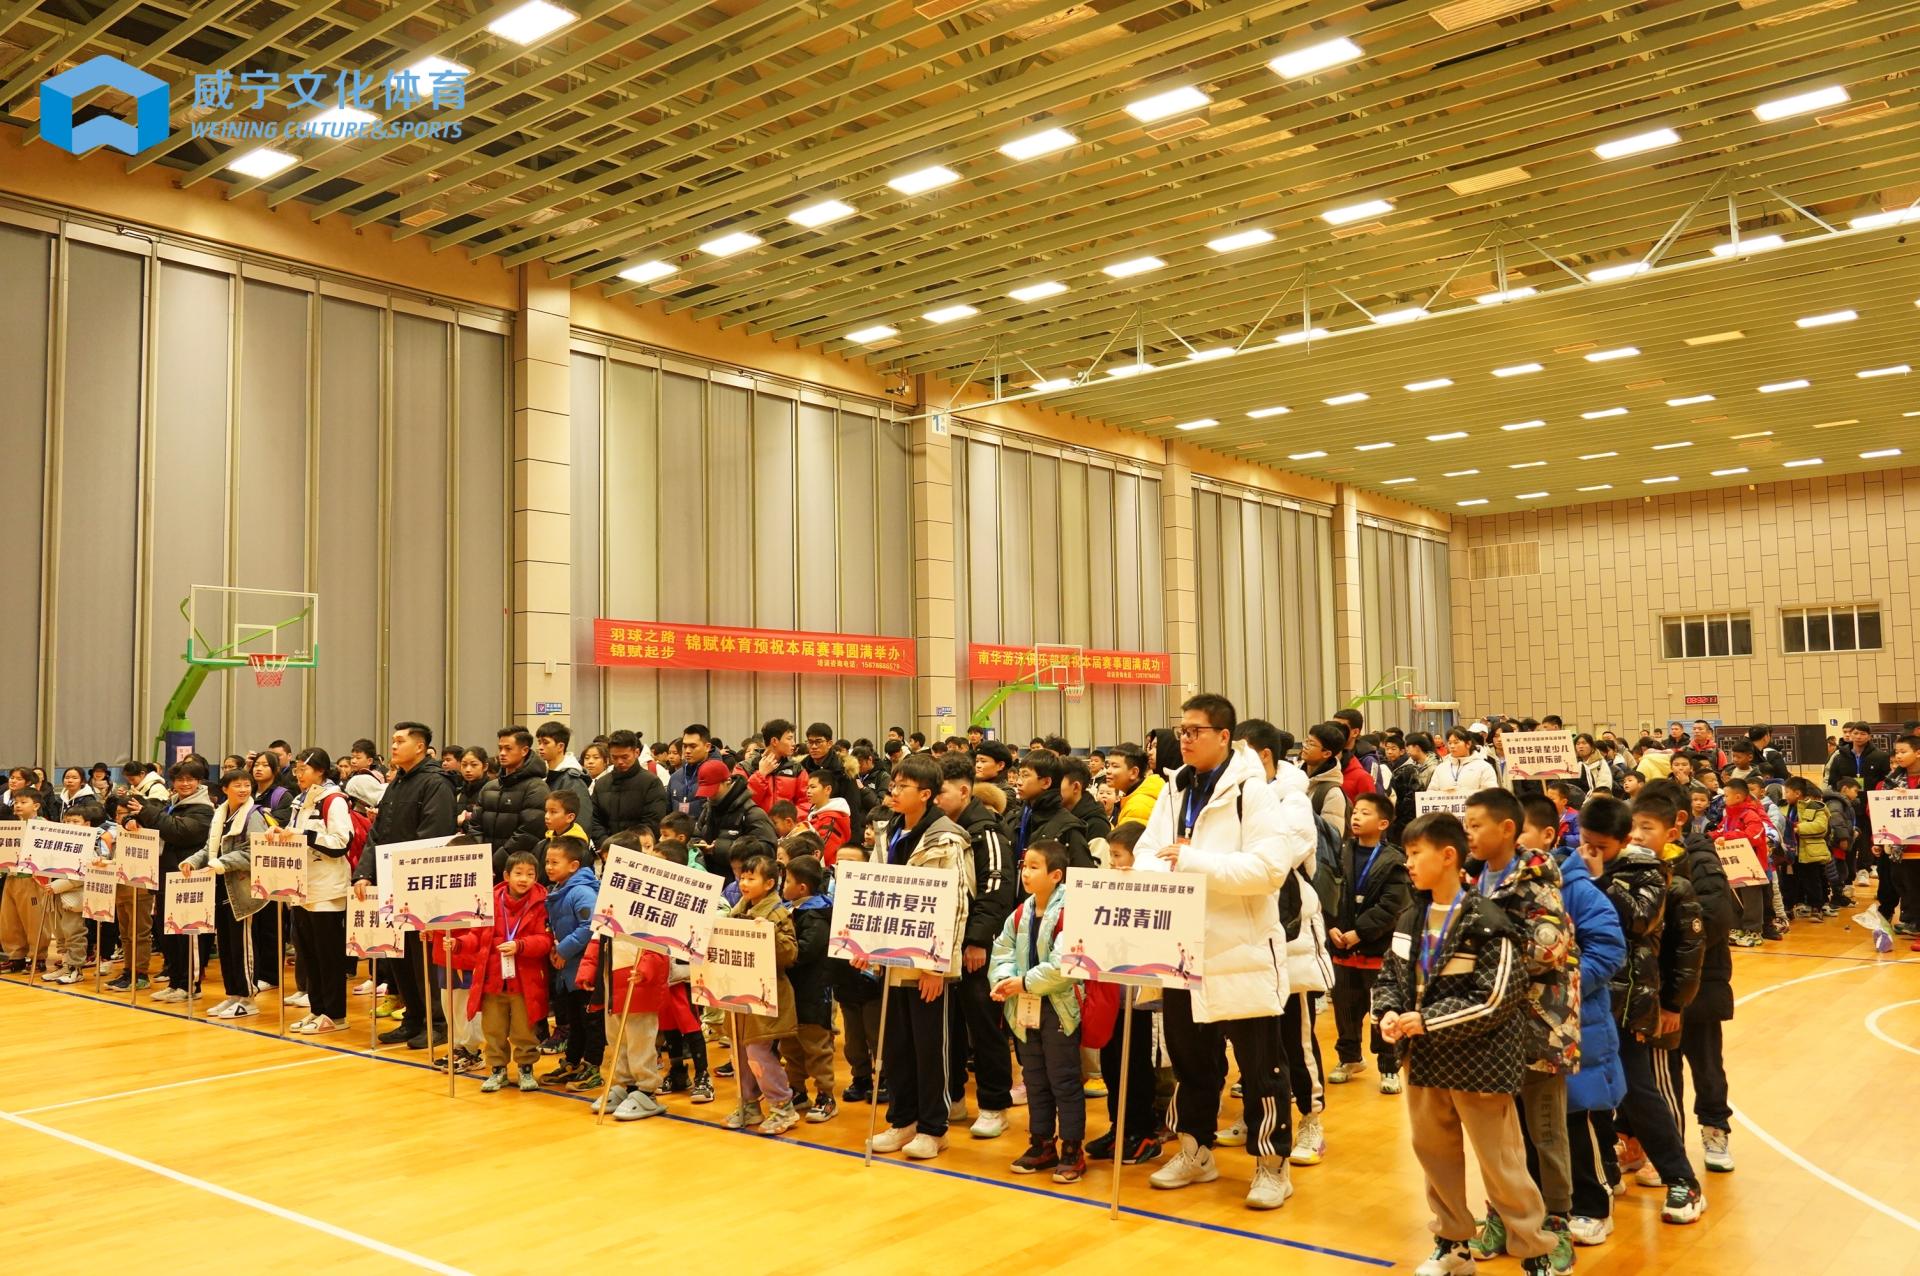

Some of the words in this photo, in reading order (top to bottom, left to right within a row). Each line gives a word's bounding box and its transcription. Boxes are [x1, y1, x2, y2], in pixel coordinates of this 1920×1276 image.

[610, 627, 676, 643] 羽球之路
[610, 643, 676, 659] 锦赋起步
[1519, 755, 1563, 765] 篮球俱乐部
[34, 838, 84, 854] 宏球俱乐部
[255, 855, 302, 870] 广西体育中心
[407, 872, 477, 891] 五月汇篮球
[615, 856, 713, 890] 第一届广西校园篮球俱乐部联赛
[845, 871, 948, 888] 第一届广西校园篮球俱乐部联赛
[609, 872, 709, 915] 萌童王国篮球
[1075, 879, 1195, 895] 第一届广西校园篮球俱乐部联赛
[851, 889, 938, 914] 玉林市复兴
[628, 900, 679, 928] 俱乐部
[1094, 905, 1172, 931] 力波青训
[848, 912, 935, 939] 篮球俱乐部
[707, 946, 756, 969] 爱动篮球
